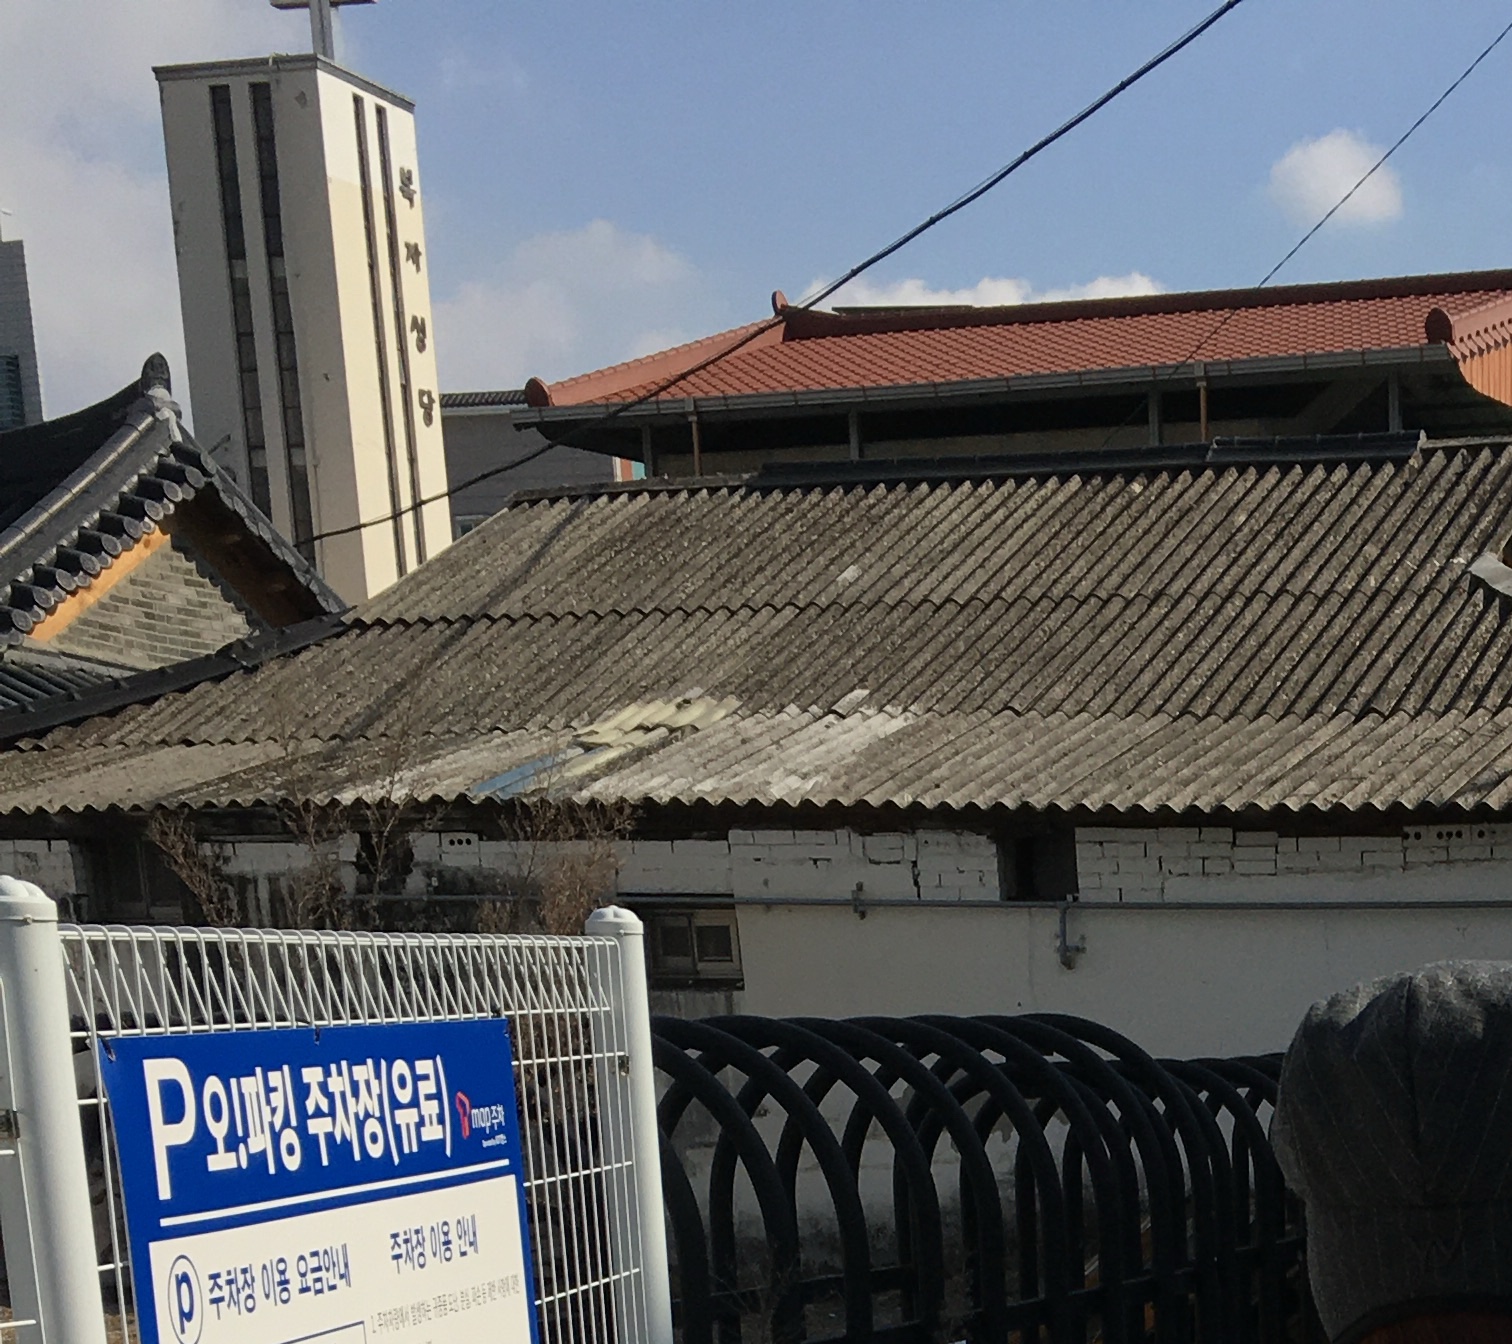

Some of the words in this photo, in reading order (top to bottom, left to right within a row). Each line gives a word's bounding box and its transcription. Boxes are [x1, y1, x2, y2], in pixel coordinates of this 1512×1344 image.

[142, 1057, 196, 1200] P
[203, 1064, 301, 1175] 오!파킹
[301, 1054, 451, 1166] 주차장(유료)
[207, 1263, 256, 1320] 주차장
[261, 1257, 291, 1306] 이용
[296, 1243, 351, 1296] 요금안내
[390, 1225, 426, 1274] 주차장
[430, 1221, 453, 1264] 이용
[456, 1214, 479, 1257] 안내
